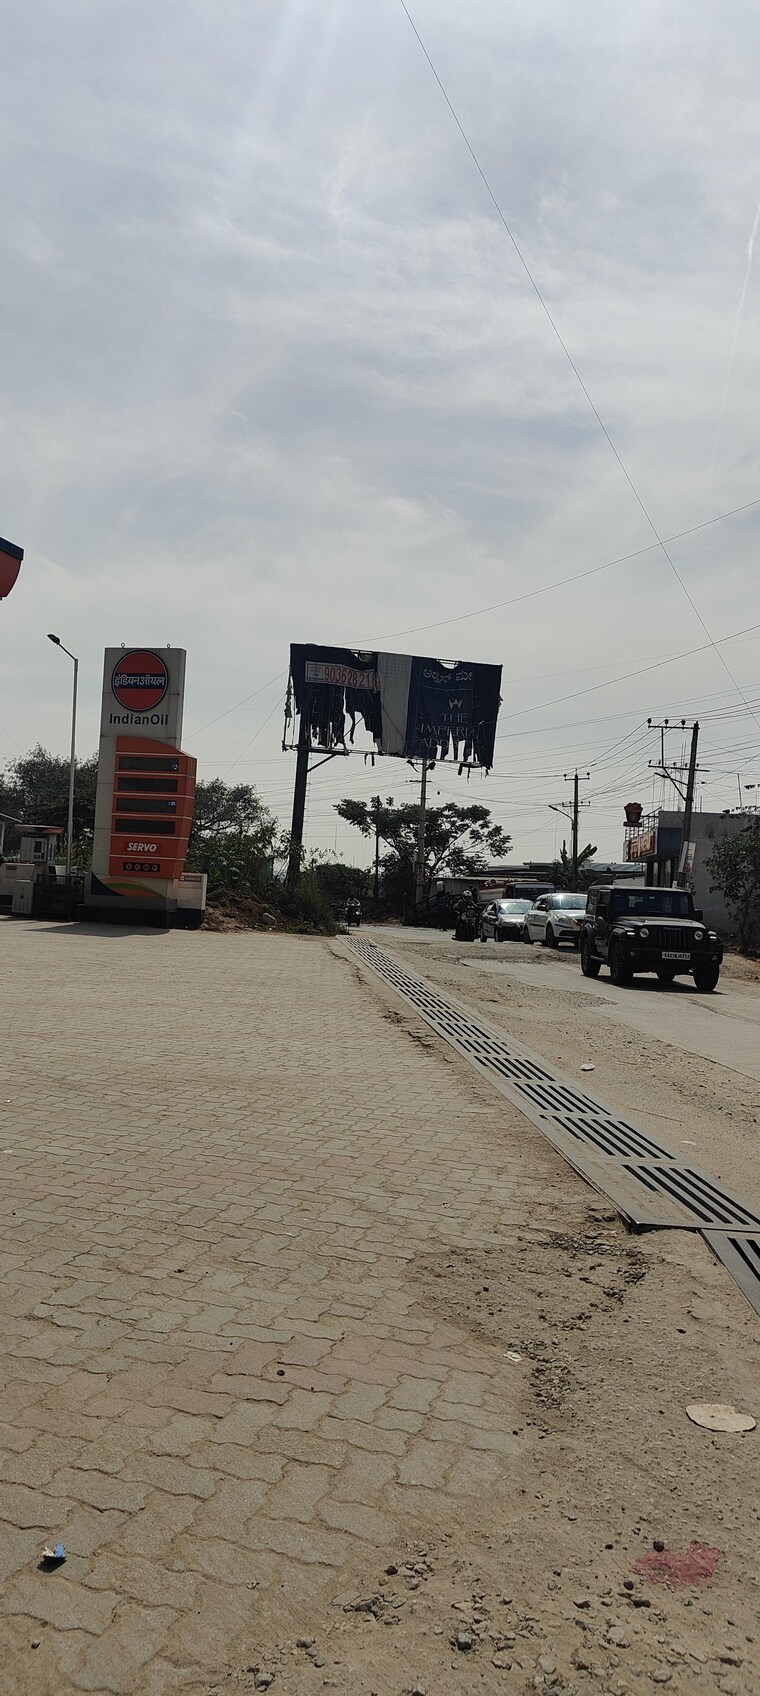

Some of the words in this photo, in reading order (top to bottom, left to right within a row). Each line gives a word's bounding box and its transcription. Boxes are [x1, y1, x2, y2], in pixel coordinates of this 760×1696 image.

[114, 674, 166, 688] इंडियनऑयल
[109, 713, 168, 726] IndianOil
[442, 713, 468, 724] THE
[127, 842, 157, 857] SERVO
